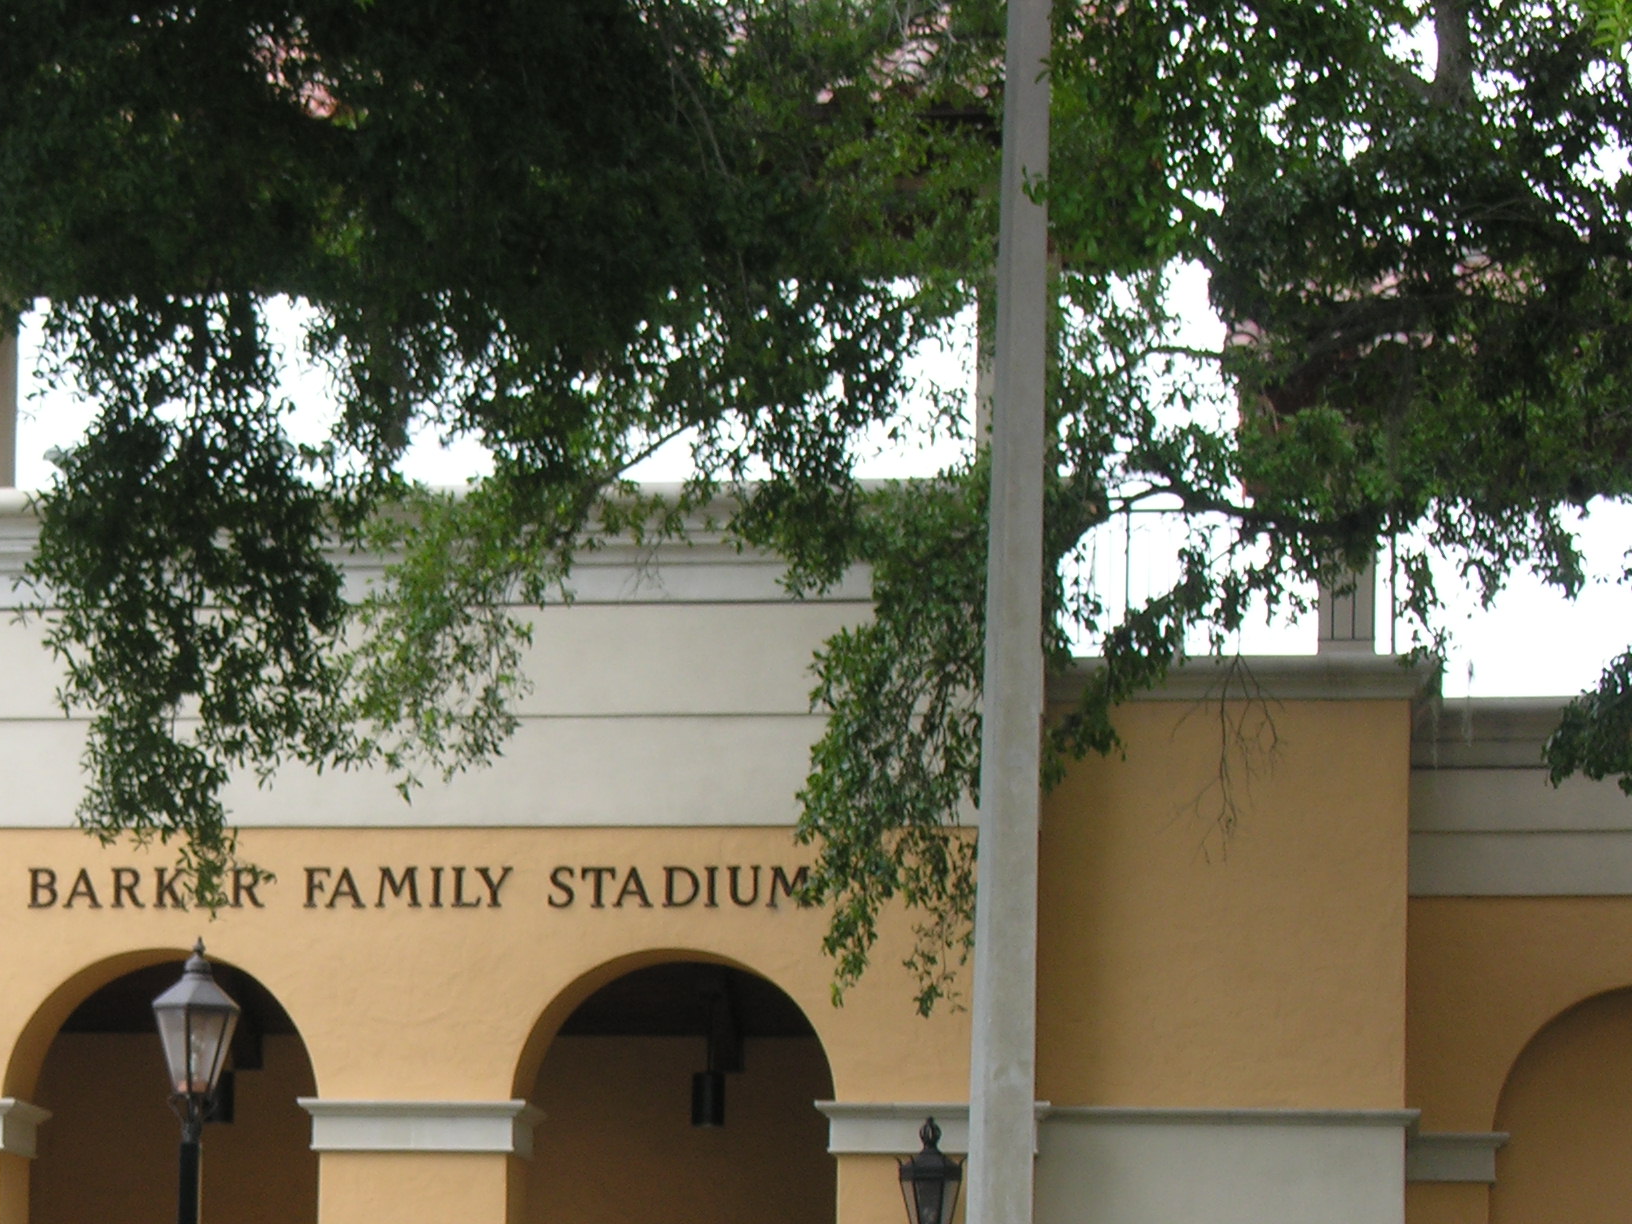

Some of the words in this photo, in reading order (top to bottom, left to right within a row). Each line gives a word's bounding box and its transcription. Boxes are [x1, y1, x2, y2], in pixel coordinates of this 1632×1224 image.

[27, 866, 266, 909] BARKR
[303, 865, 514, 909] FAMILY
[546, 864, 814, 909] STADIUM
